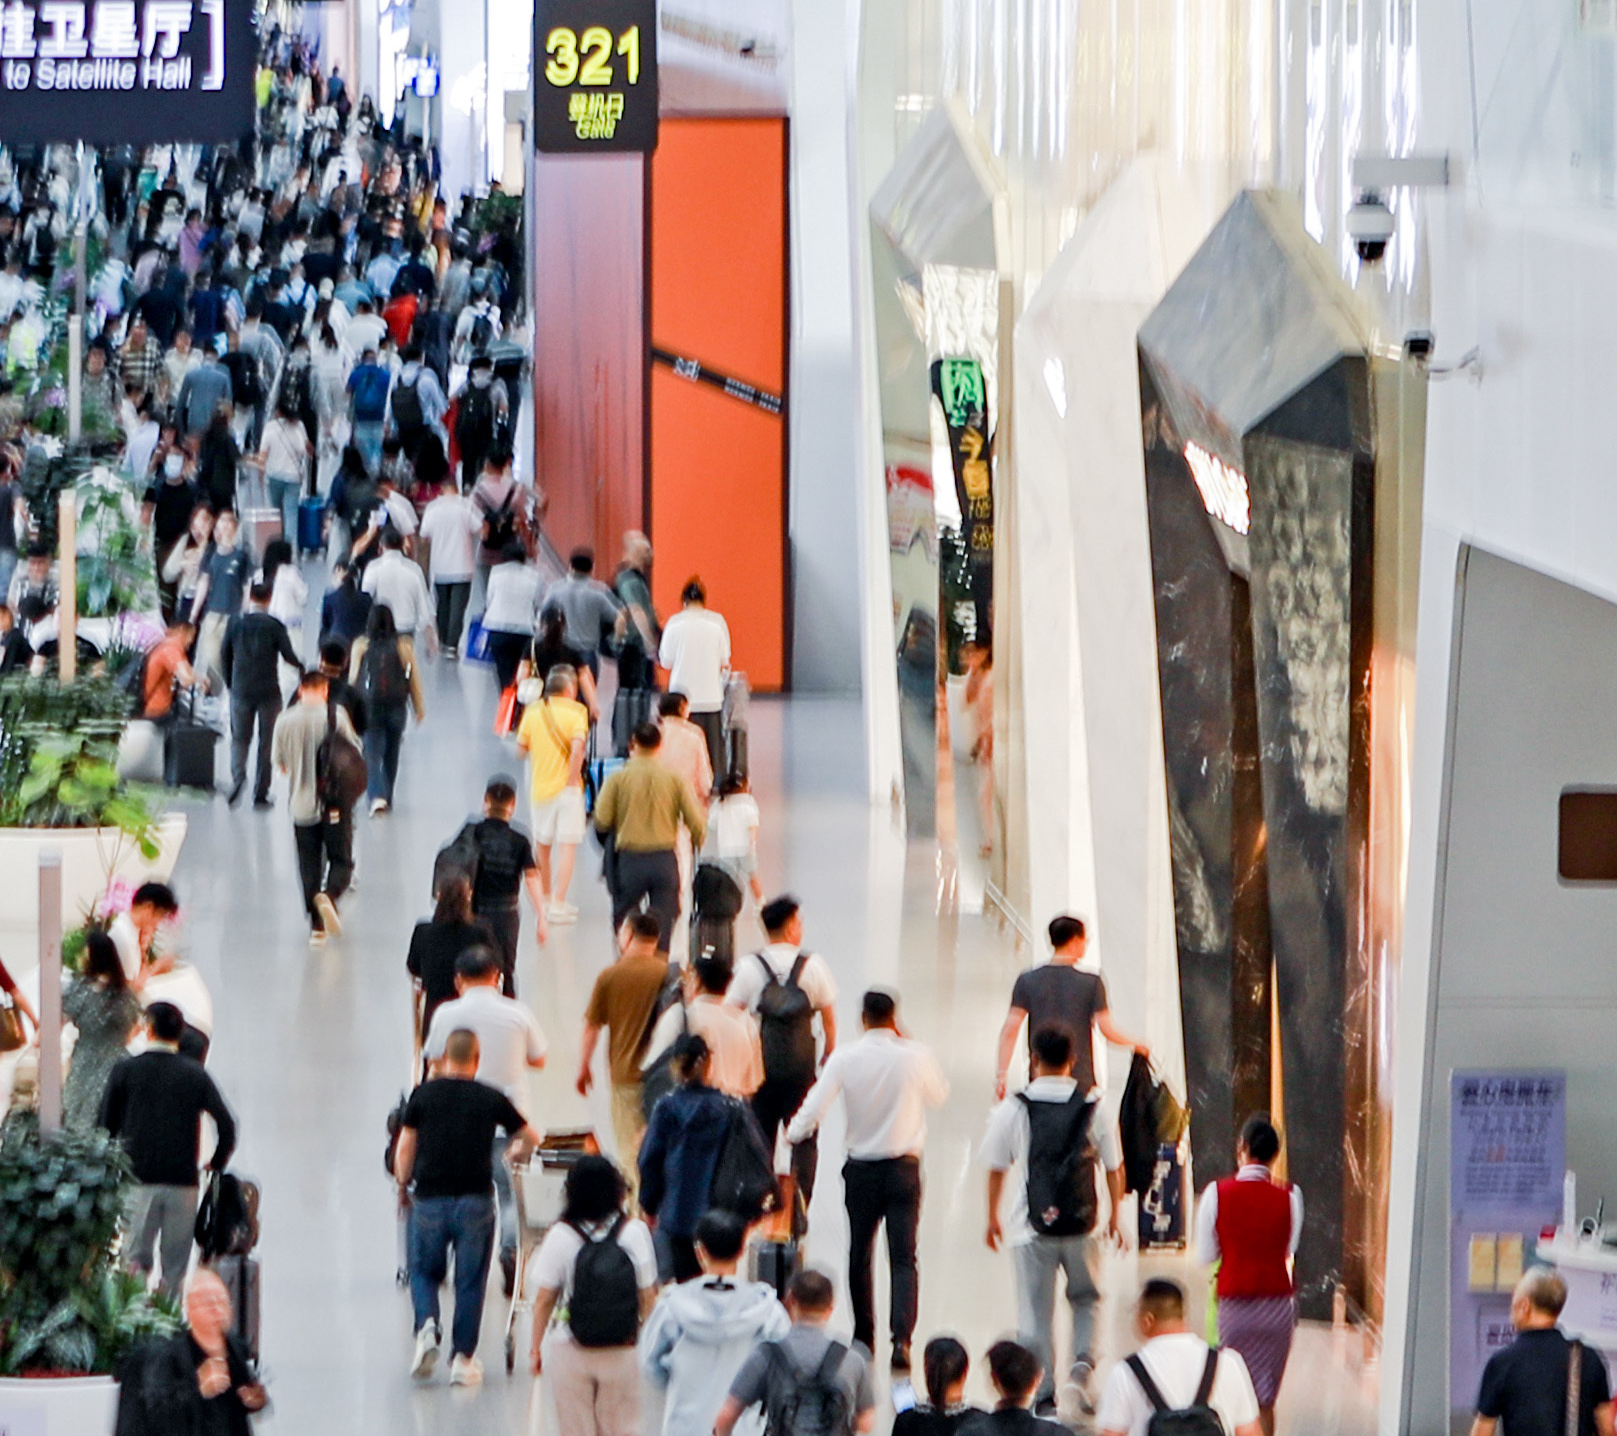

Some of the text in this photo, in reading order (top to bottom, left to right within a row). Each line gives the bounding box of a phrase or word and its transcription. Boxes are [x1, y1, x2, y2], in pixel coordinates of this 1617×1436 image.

[4, 58, 31, 90] to
[35, 57, 137, 90] Satellite
[141, 57, 192, 90] Hall
[545, 25, 640, 87] 321
